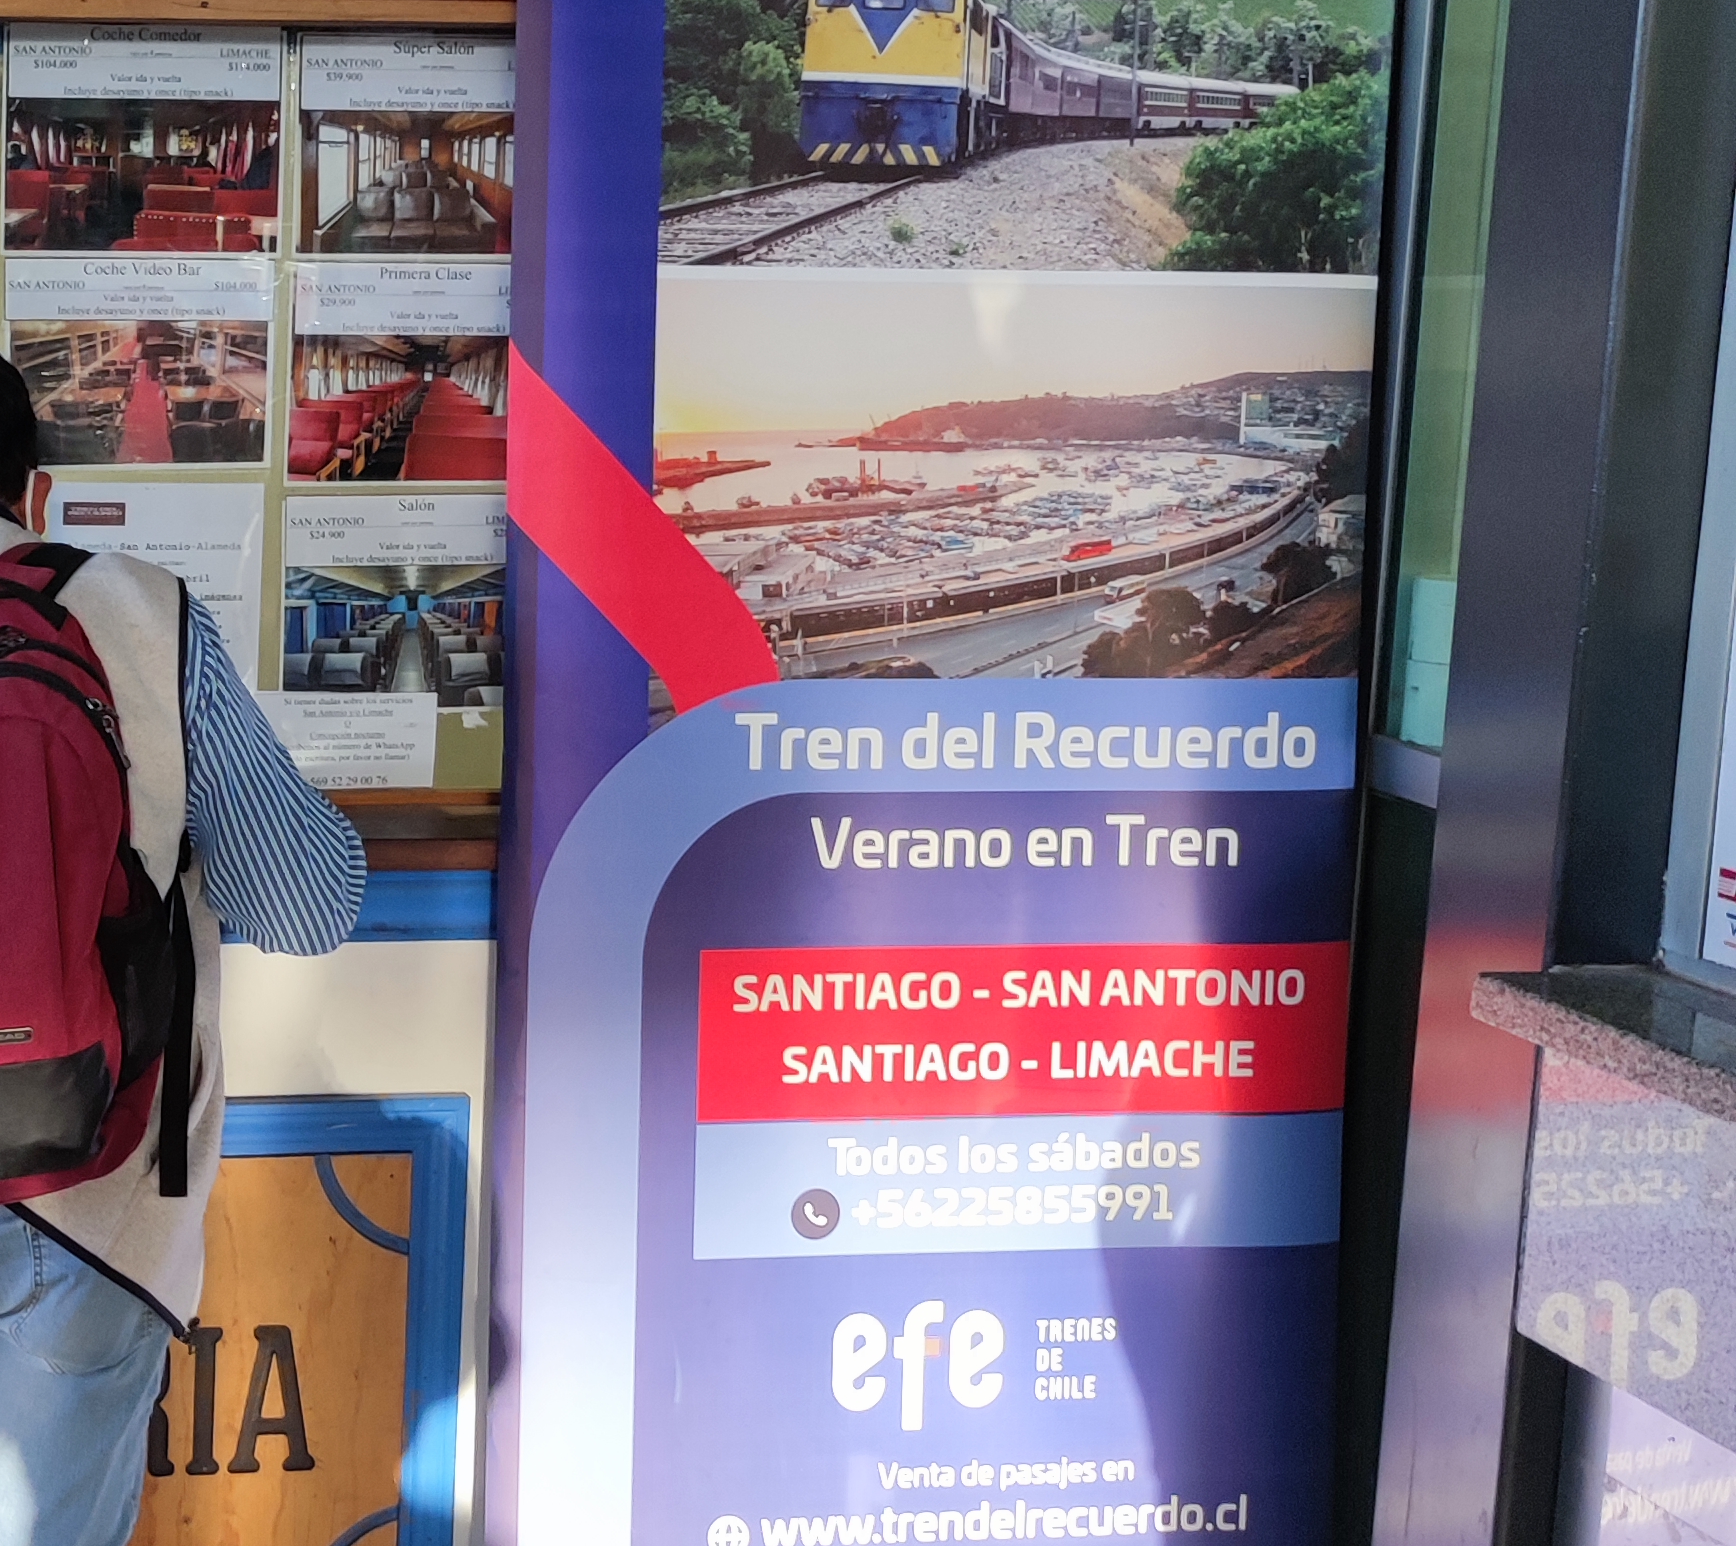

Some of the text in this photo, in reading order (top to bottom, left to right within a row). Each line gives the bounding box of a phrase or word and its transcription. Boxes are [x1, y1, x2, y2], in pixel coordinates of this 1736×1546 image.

[90, 27, 201, 42] Coche Comedor
[14, 45, 271, 59] SAN ANTONIO LIMACHE
[393, 41, 474, 57] Súper Salón
[33, 59, 77, 69] $104.000
[307, 59, 383, 68] SAN ANTONIO
[110, 73, 181, 83] Valor ida vuelta
[327, 72, 362, 82] $39.900
[64, 86, 98, 97] Incluye
[100, 86, 144, 98] desayuno
[179, 87, 201, 97] (tipo
[203, 88, 233, 97] snack)
[398, 86, 467, 96] Valor ida vuelta
[84, 263, 201, 276] Coche Video Bar
[380, 267, 472, 280] Primera Clase
[9, 281, 257, 291] SAN ANTONIO $104.000
[301, 285, 376, 294] SAN ANTONIO
[103, 294, 125, 302] Valor
[127, 294, 139, 302] ida
[320, 298, 356, 307] $29.900
[57, 306, 91, 316] Incluye
[93, 306, 136, 317] desayuno
[147, 307, 169, 315] once
[171, 306, 193, 316] (tipo
[390, 311, 458, 320] Valor ida vuelta
[399, 499, 435, 511] Salón
[290, 518, 312, 526] SAN
[315, 518, 364, 526] ANTONIO
[379, 542, 446, 551] Valor ida vuelta
[332, 554, 365, 563] Incluye
[366, 555, 408, 564] desayuno
[418, 555, 439, 563] once
[442, 554, 462, 564] (tipo
[375, 742, 415, 751] WhatsApp
[735, 712, 1316, 771] Tren del Recuerdo
[346, 777, 357, 785] 29
[376, 775, 388, 784] 76
[810, 814, 1239, 870] Verano en Tren
[733, 967, 1305, 1013] SANTIAGO SAN ANTONIO
[782, 1041, 1254, 1084] SANTIAGO LIMACHE
[828, 1132, 1200, 1176] Todos los sábados
[851, 1185, 1174, 1229] +56225855991
[1035, 1317, 1116, 1343] TRENES
[831, 1300, 1005, 1431] efe
[1036, 1347, 1063, 1373] DE
[1034, 1375, 1097, 1402] CHILE
[878, 1457, 1135, 1491] Venta de pasajes en
